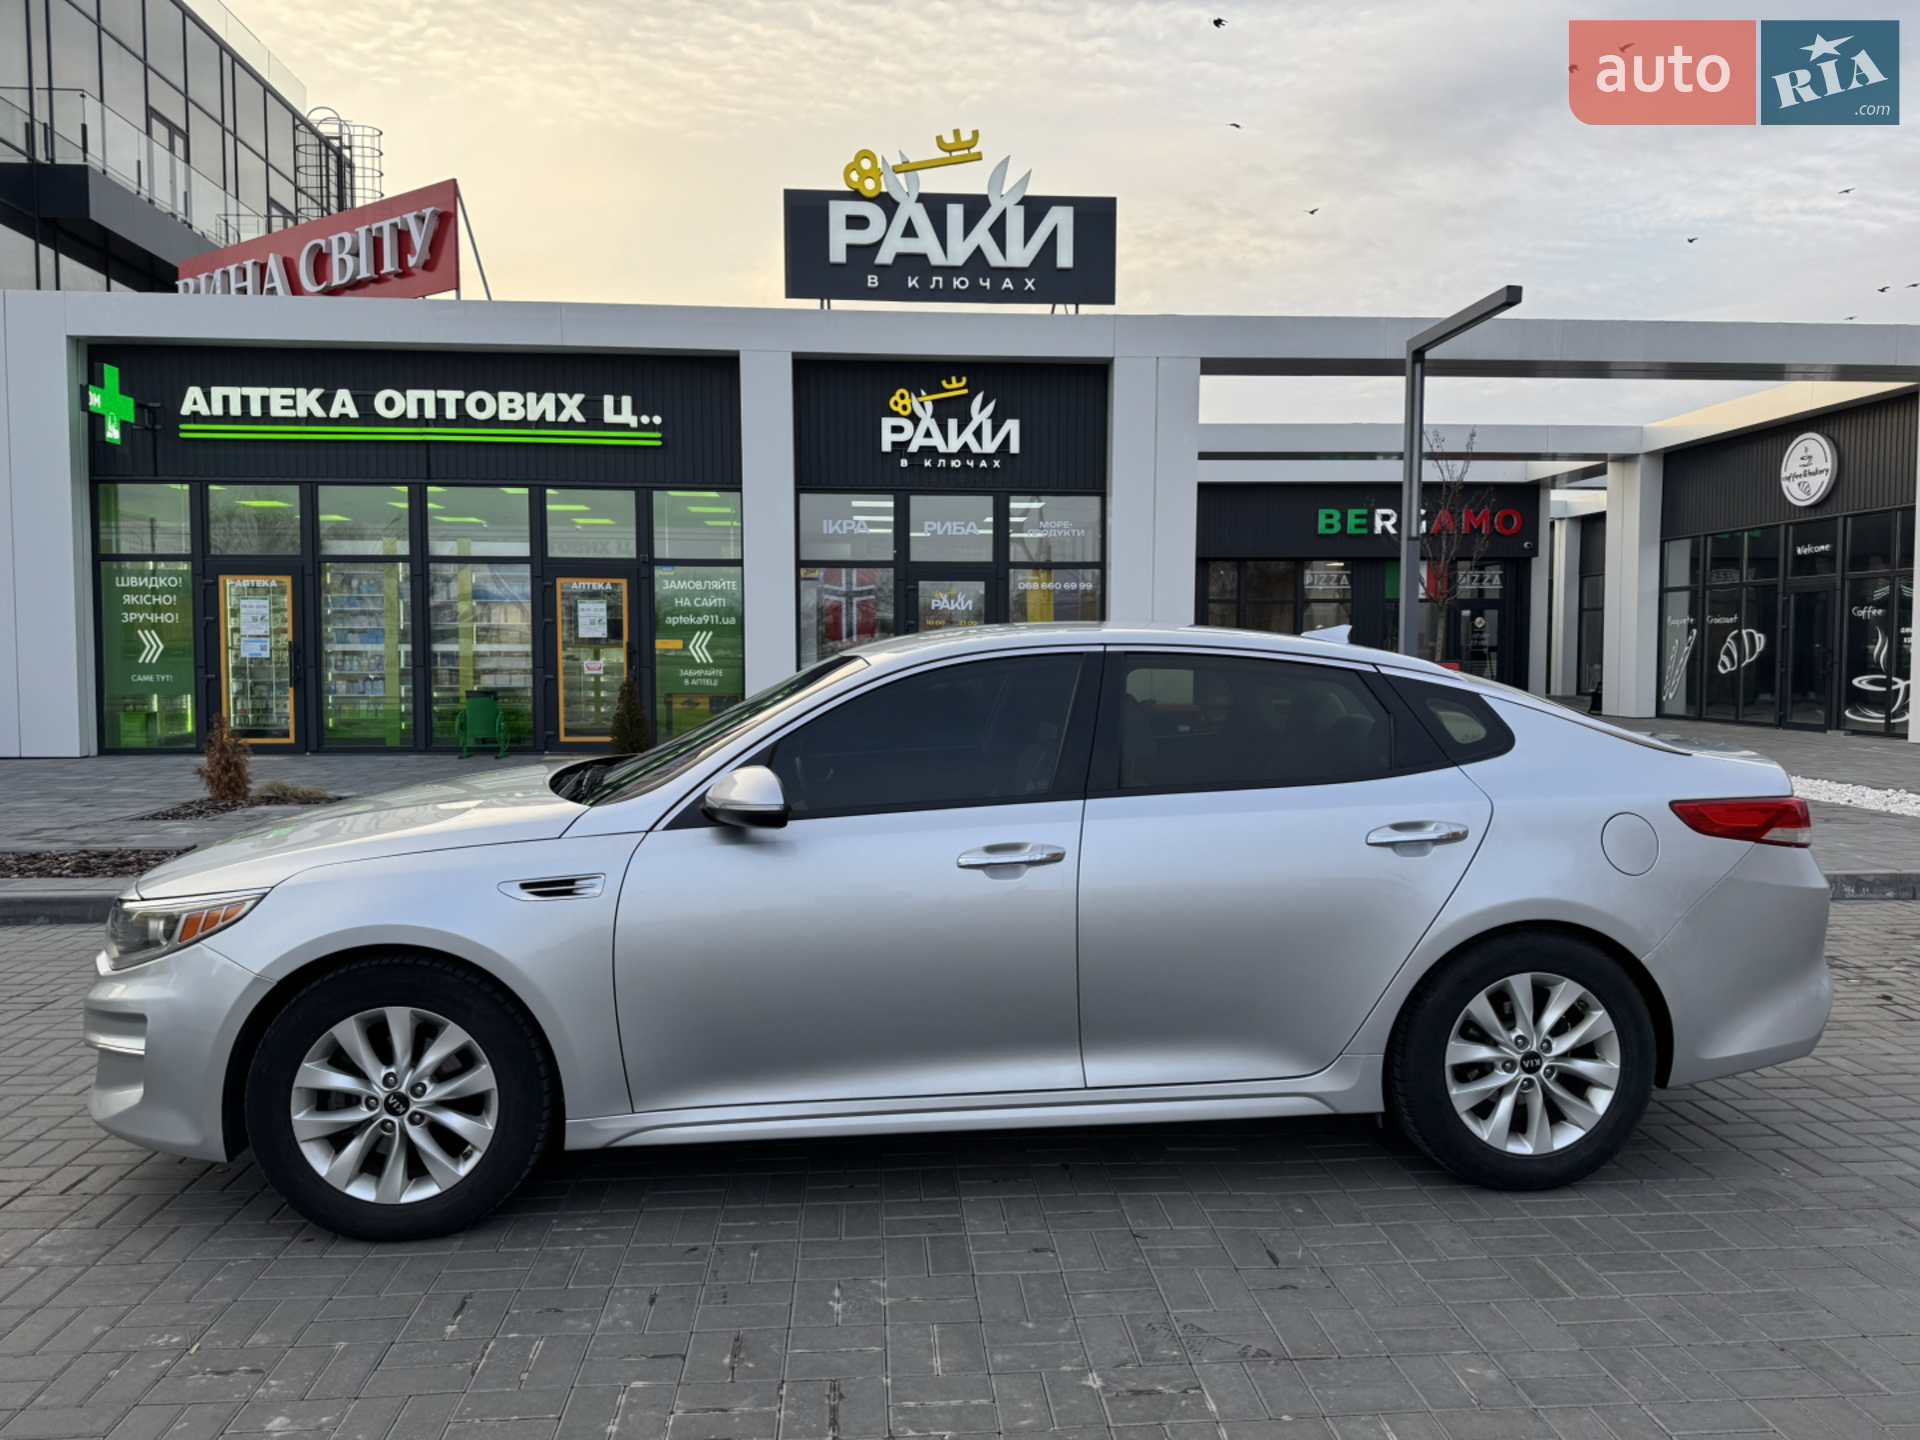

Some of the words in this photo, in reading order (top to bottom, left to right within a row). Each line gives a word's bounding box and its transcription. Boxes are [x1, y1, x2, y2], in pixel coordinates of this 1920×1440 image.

[828, 200, 1074, 269] РАКИ
[300, 207, 441, 294] СВІТУ
[867, 274, 879, 288] В
[907, 275, 1036, 290] КЛЮЧАХ
[180, 386, 359, 419] АПТЕКА
[373, 389, 586, 423] ОПТОВИХ
[881, 417, 1020, 454] РАКИ
[900, 458, 908, 467] В
[924, 458, 1001, 468] КЛЮЧАХ
[822, 519, 870, 535] ІКРА
[923, 520, 980, 536] РИБА
[1027, 529, 1085, 538] ПРОДУКТИ
[1796, 543, 1833, 555] Welcome
[115, 576, 183, 589] ШВИДКО!
[235, 579, 278, 588] АПТЕКА
[571, 581, 613, 590] АПТЕКА
[662, 578, 738, 590] ЗАМОВЛЯЙТЕ
[1018, 582, 1039, 590] 068
[1063, 582, 1077, 590] 69
[1079, 582, 1093, 590] 99
[1306, 574, 1349, 586] PIZZA
[122, 594, 177, 606] ЯКІСНО!
[674, 597, 692, 608] НА
[694, 595, 726, 608] САЙТІ
[931, 599, 973, 611] РАКИ
[121, 612, 179, 623] ЗРУЧНО!
[1706, 613, 1740, 624] Croissant
[1852, 605, 1886, 620] Coffee
[665, 614, 736, 627] apteka911.ua
[131, 674, 154, 683] САМЕ
[156, 674, 173, 683] ТУТ!
[679, 667, 724, 678] ЗАБИРАЙТЕ
[1522, 1059, 1541, 1068] KIA
[387, 1095, 407, 1114] KIA
